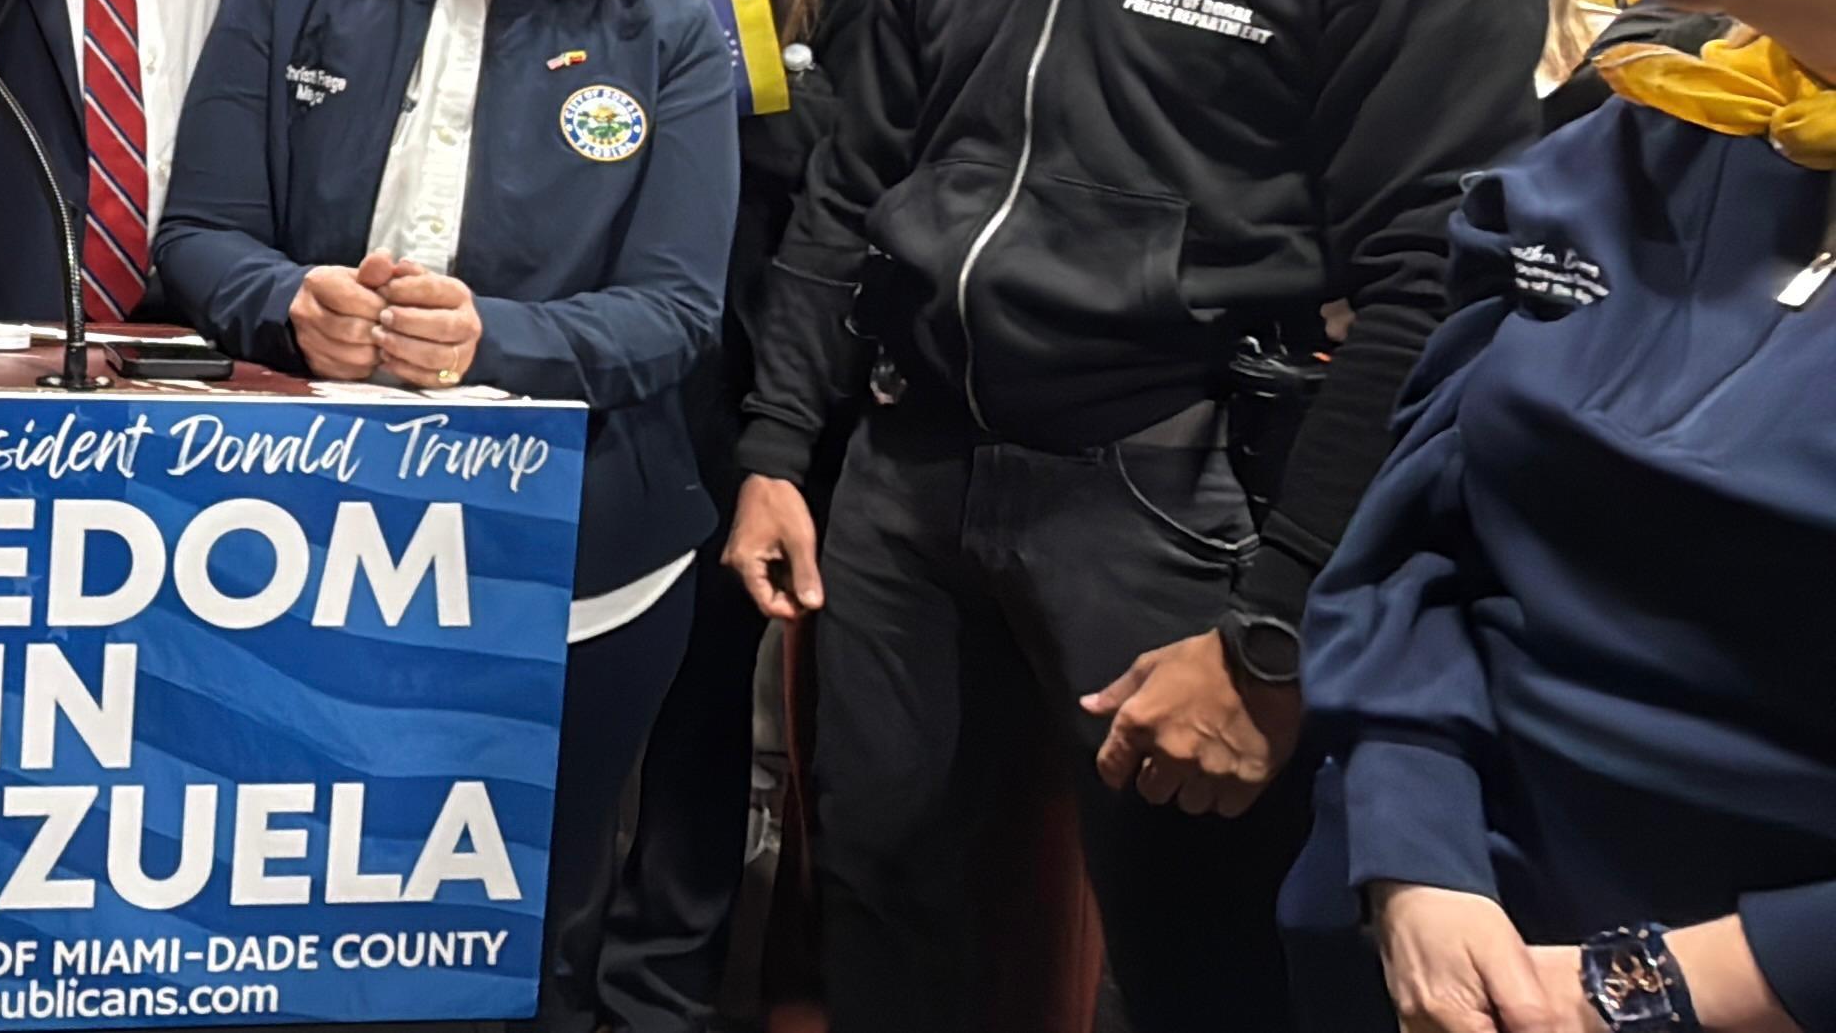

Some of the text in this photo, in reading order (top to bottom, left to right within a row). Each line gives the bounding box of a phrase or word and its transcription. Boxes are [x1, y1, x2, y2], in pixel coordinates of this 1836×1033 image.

[1172, 7, 1274, 44] DEPARTMENT
[166, 413, 366, 482] Donald
[385, 413, 551, 493] Trump
[52, 934, 320, 975] MIAMI-DADE
[332, 930, 510, 969] COUNTY
